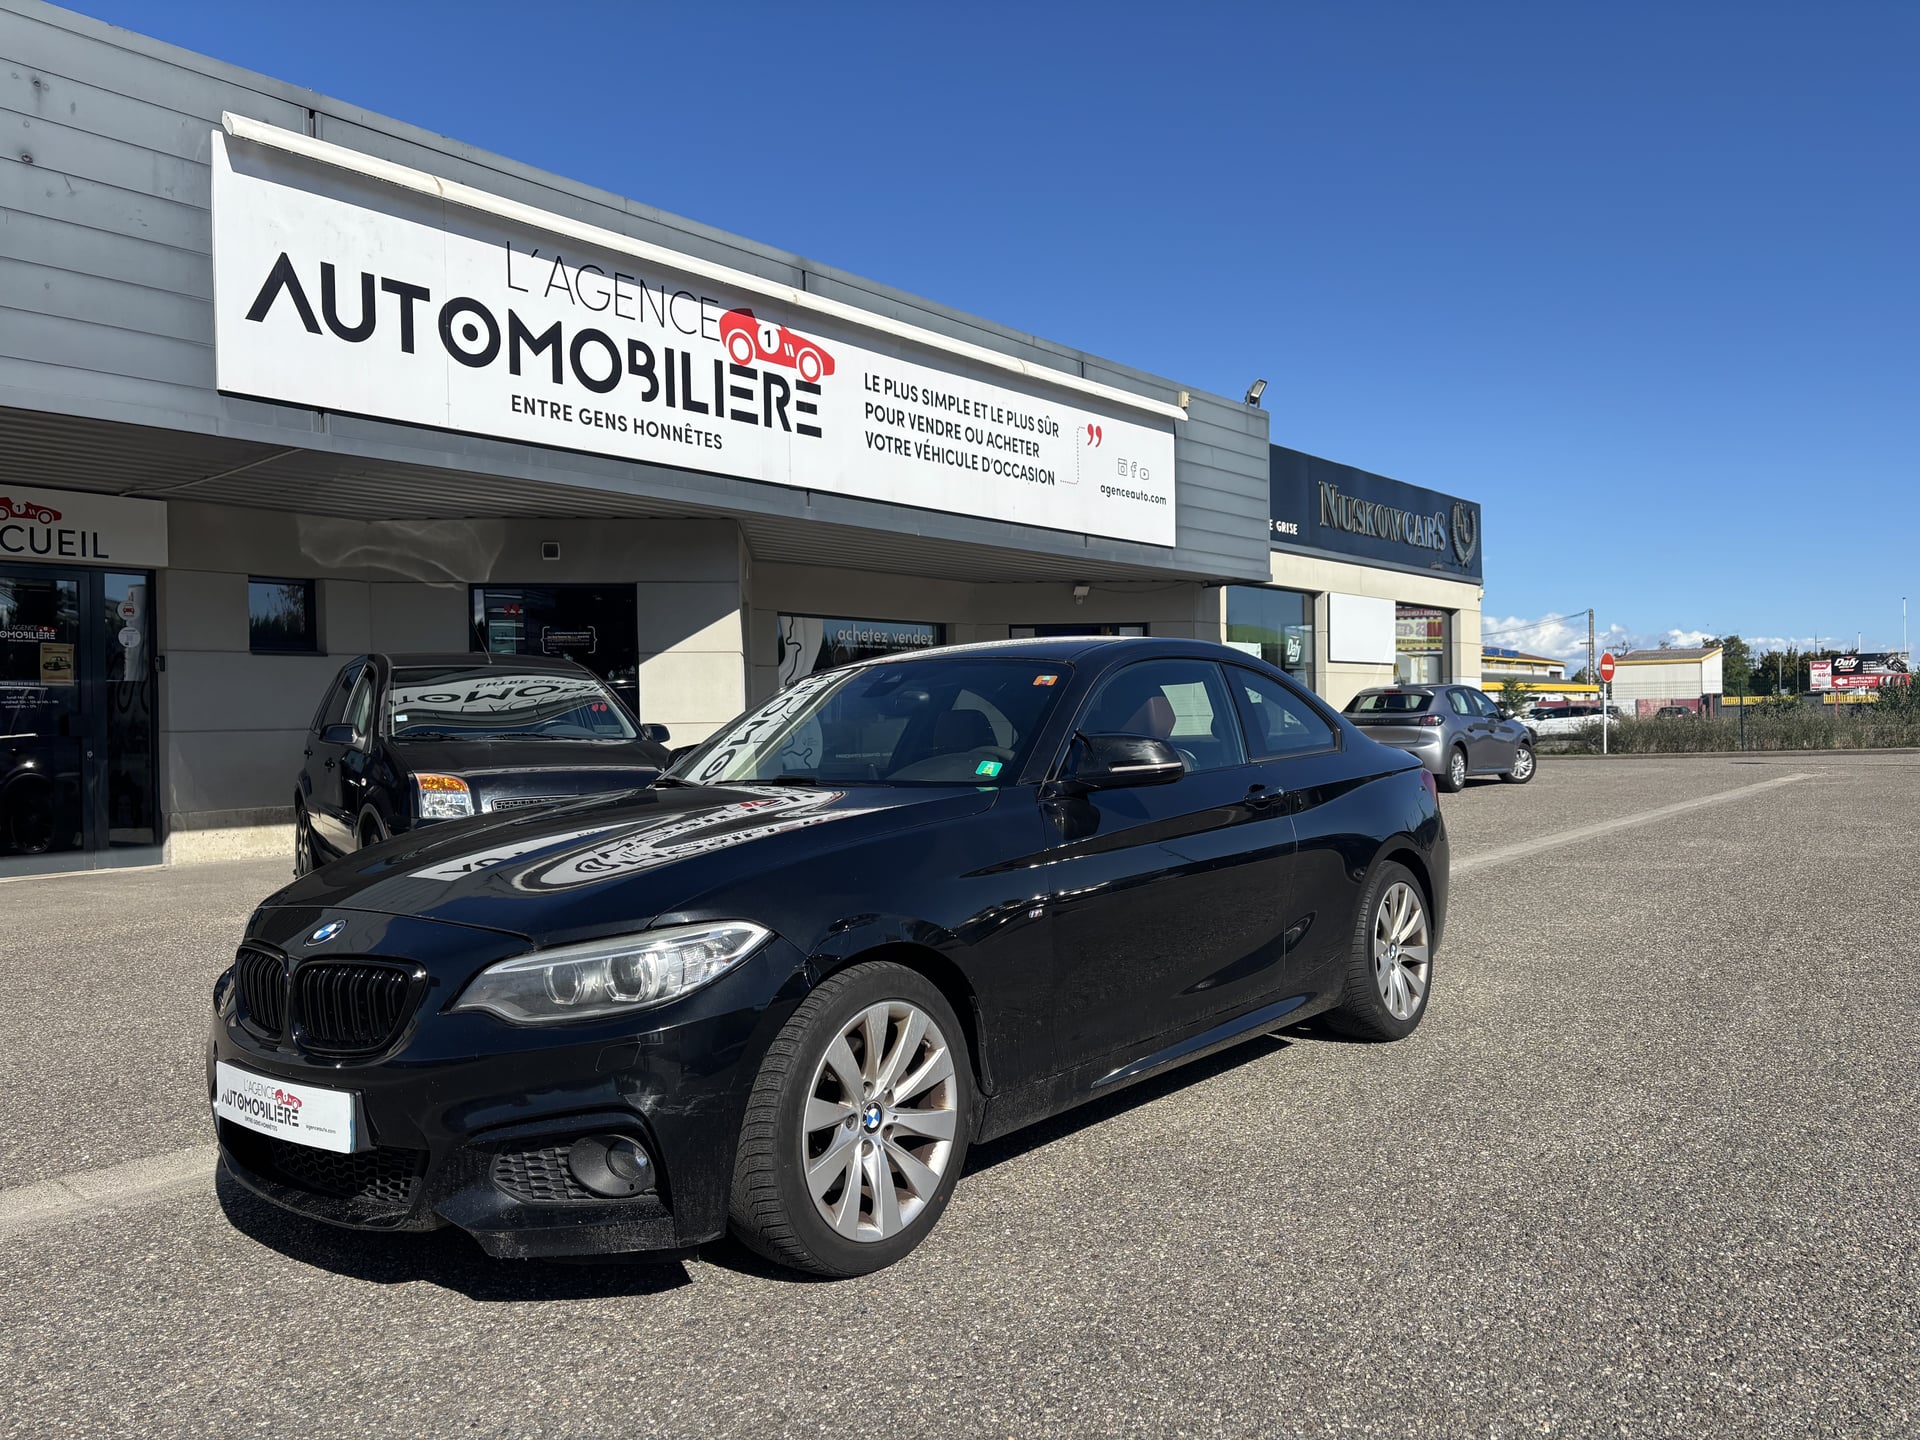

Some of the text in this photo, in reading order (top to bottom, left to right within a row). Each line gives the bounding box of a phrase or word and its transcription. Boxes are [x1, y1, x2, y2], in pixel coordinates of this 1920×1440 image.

[511, 394, 723, 450] ENTRE GENS HONNÊTES
[865, 372, 1060, 439] LE PLUS SIMPLE ET LE PLUS SÛR
[865, 402, 1041, 459] POUR VENDRE OU ACHETER
[864, 430, 1056, 486] VOTRE VÉHICULE D'OCCASION
[1099, 484, 1168, 506] agenceauto.com
[0, 525, 109, 559] CUEIL
[1276, 519, 1298, 536] GRISE
[837, 623, 935, 645] achetez vendez
[1834, 657, 1860, 669] Dafy
